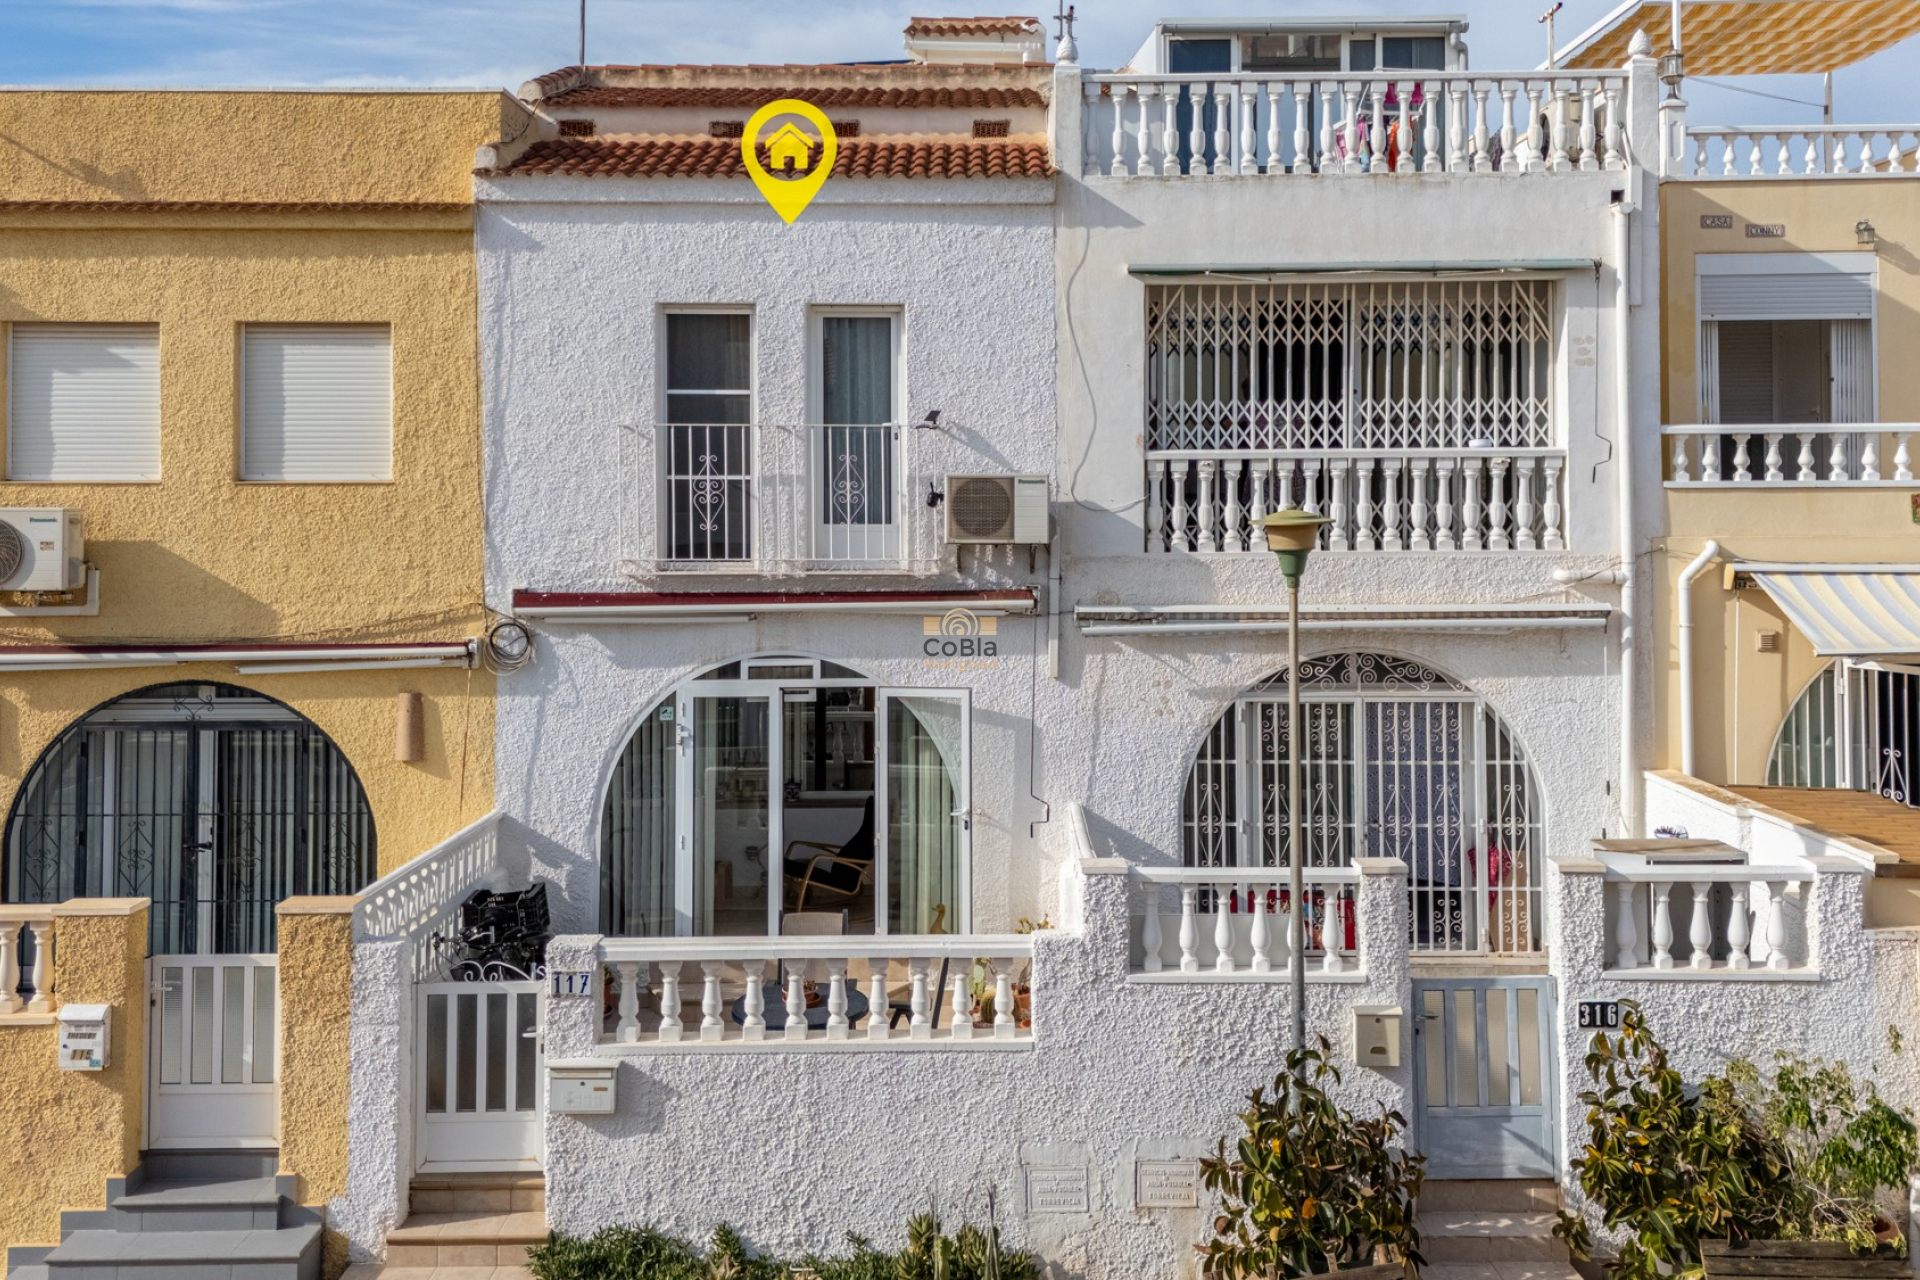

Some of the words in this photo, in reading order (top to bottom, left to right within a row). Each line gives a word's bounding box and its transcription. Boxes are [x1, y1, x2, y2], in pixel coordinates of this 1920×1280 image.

[1704, 217, 1729, 228] CASA
[554, 974, 590, 994] 117
[1580, 1004, 1617, 1026] 316
